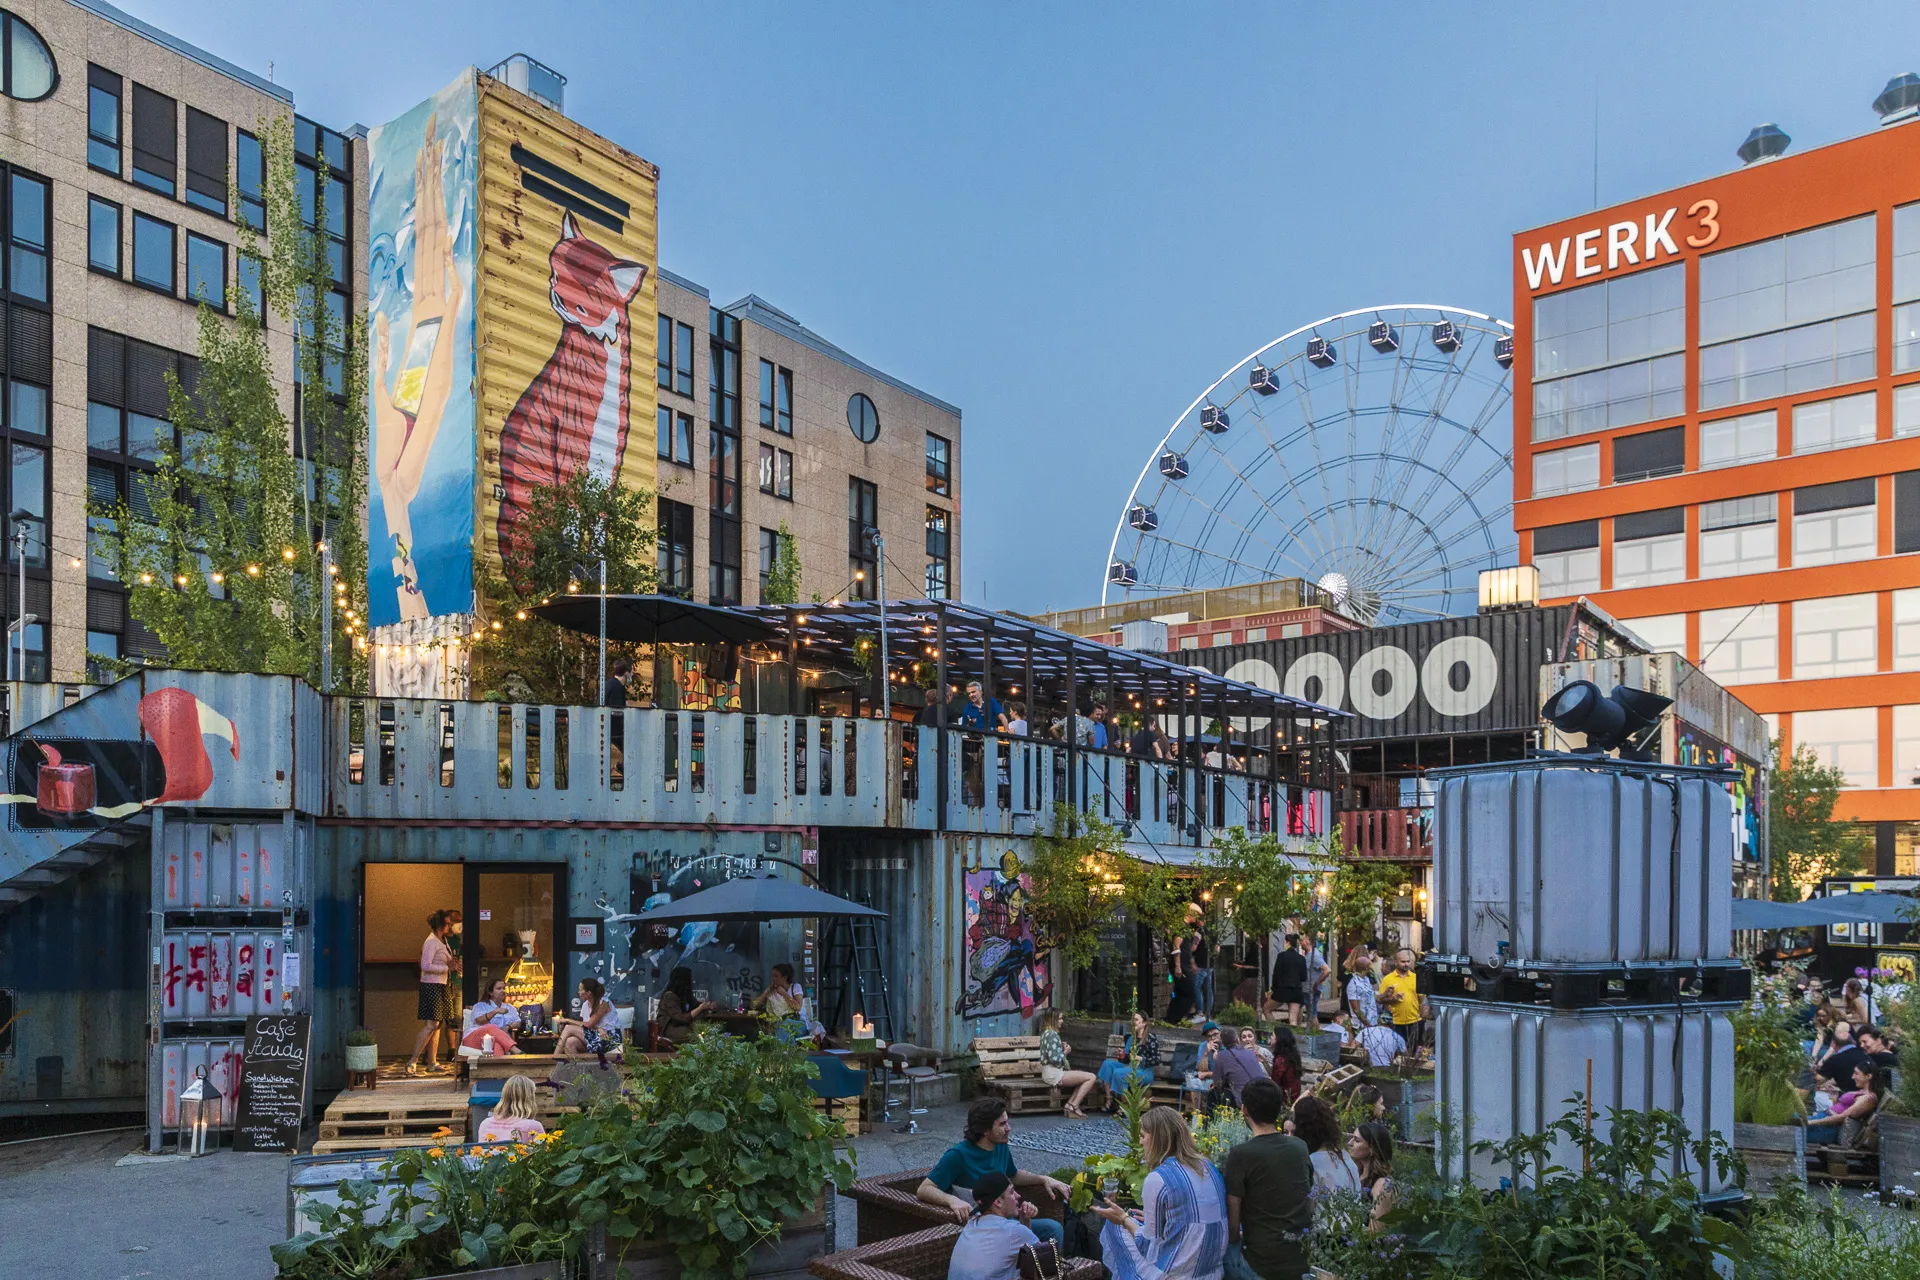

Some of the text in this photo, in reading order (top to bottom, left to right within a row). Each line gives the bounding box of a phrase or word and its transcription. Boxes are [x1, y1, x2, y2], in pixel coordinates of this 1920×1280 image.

[1521, 199, 1721, 290] WERK 3
[256, 1017, 297, 1042] Café
[247, 1036, 305, 1061] Acuda
[245, 1071, 296, 1084] Sandwiches
